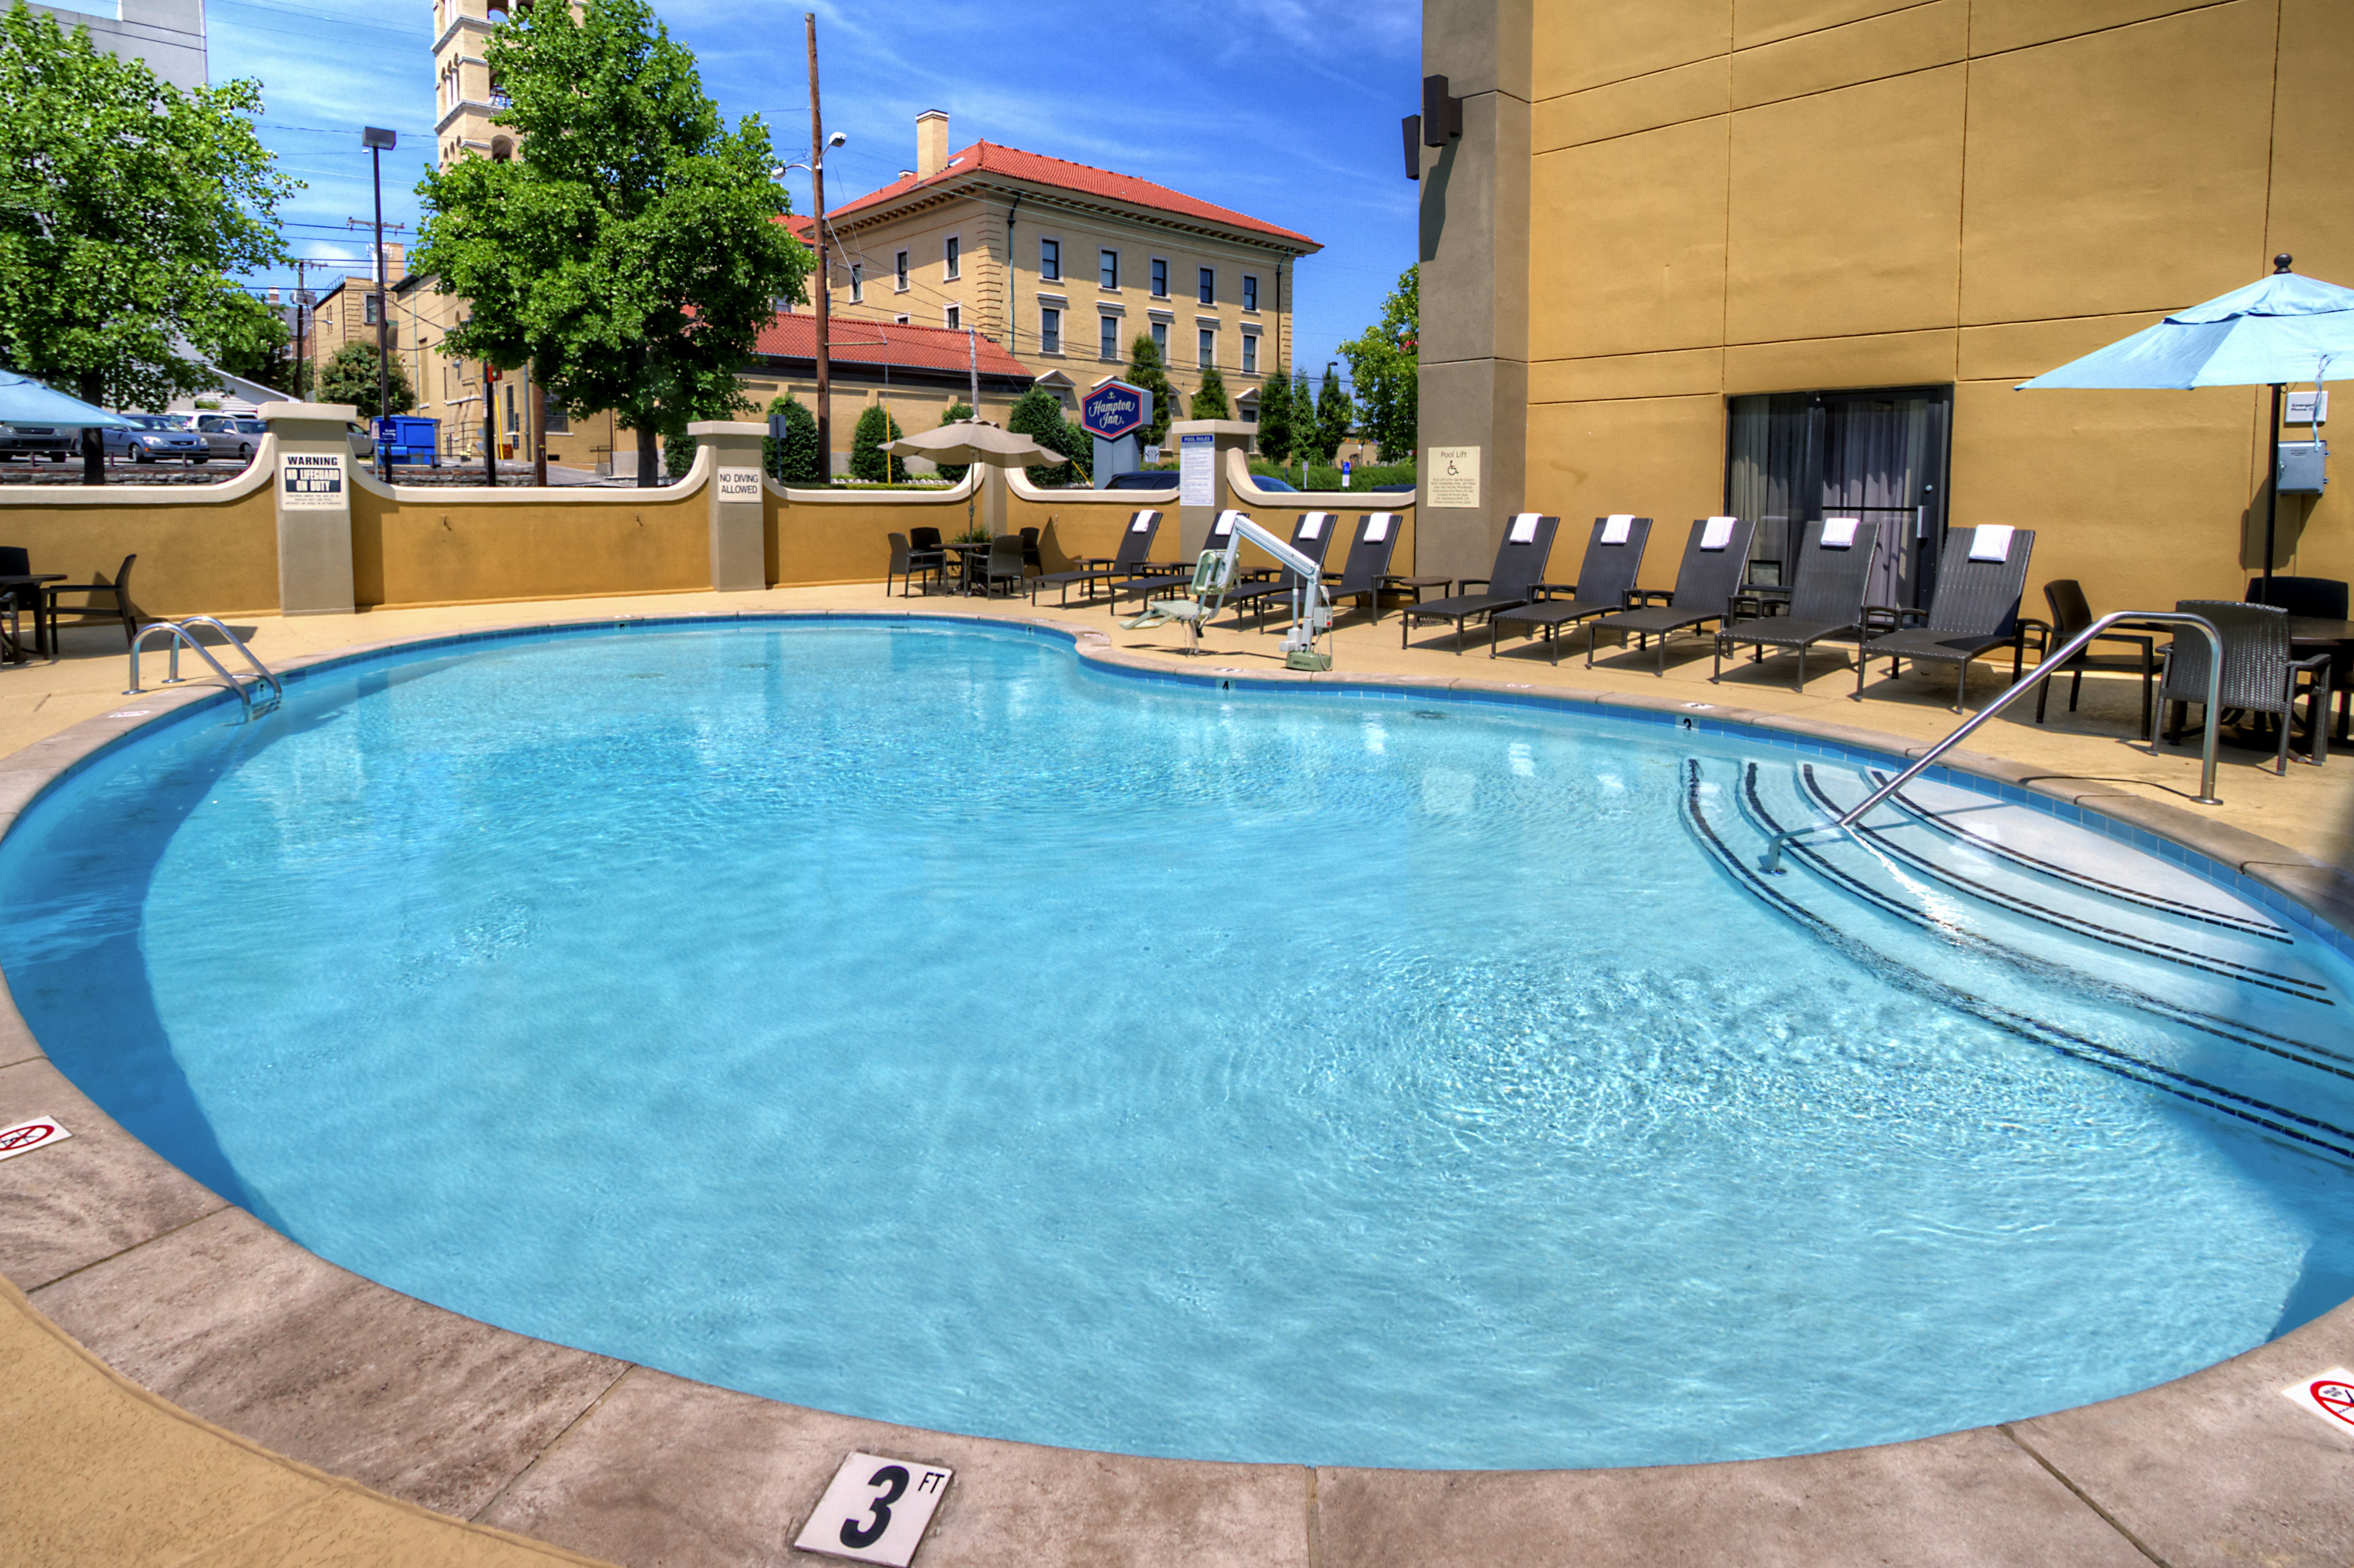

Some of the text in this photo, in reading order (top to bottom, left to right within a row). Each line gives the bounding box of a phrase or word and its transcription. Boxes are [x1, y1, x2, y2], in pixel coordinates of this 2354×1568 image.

[1089, 400, 1135, 417] Hampton
[287, 456, 338, 466] WARNING
[286, 469, 339, 481] NO LIFEGUARD
[720, 474, 758, 482] NO DIVING
[296, 480, 330, 491] ON DUTY
[721, 485, 758, 493] ALLOWED
[840, 1465, 945, 1549] 3 FT
